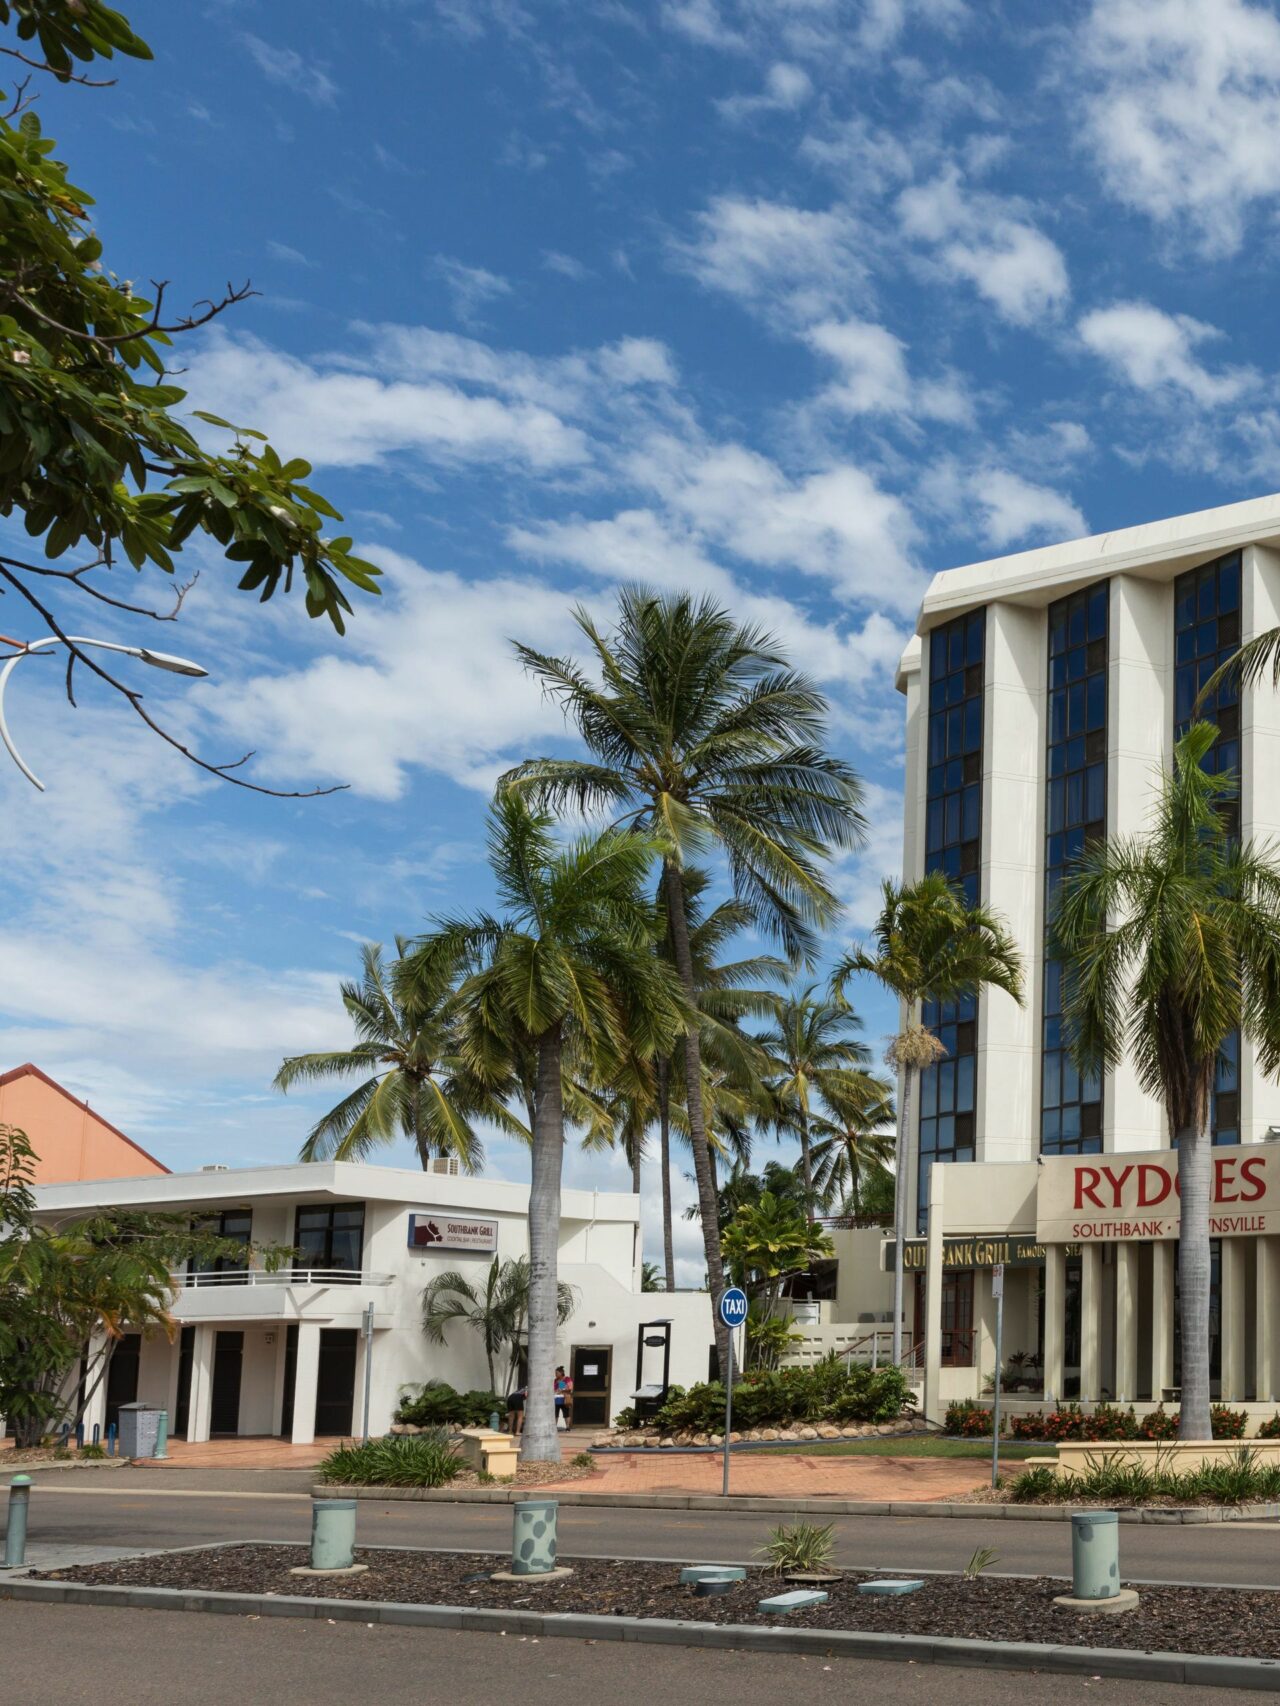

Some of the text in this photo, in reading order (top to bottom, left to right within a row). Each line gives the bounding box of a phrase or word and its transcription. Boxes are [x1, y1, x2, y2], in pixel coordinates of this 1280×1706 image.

[1073, 1157, 1267, 1209] RYDES
[447, 1223, 479, 1235] SOUTHBANK
[1073, 1220, 1163, 1238] SOUTHBANK
[975, 1241, 1011, 1265] GRILL
[724, 1299, 745, 1315] TAXI
